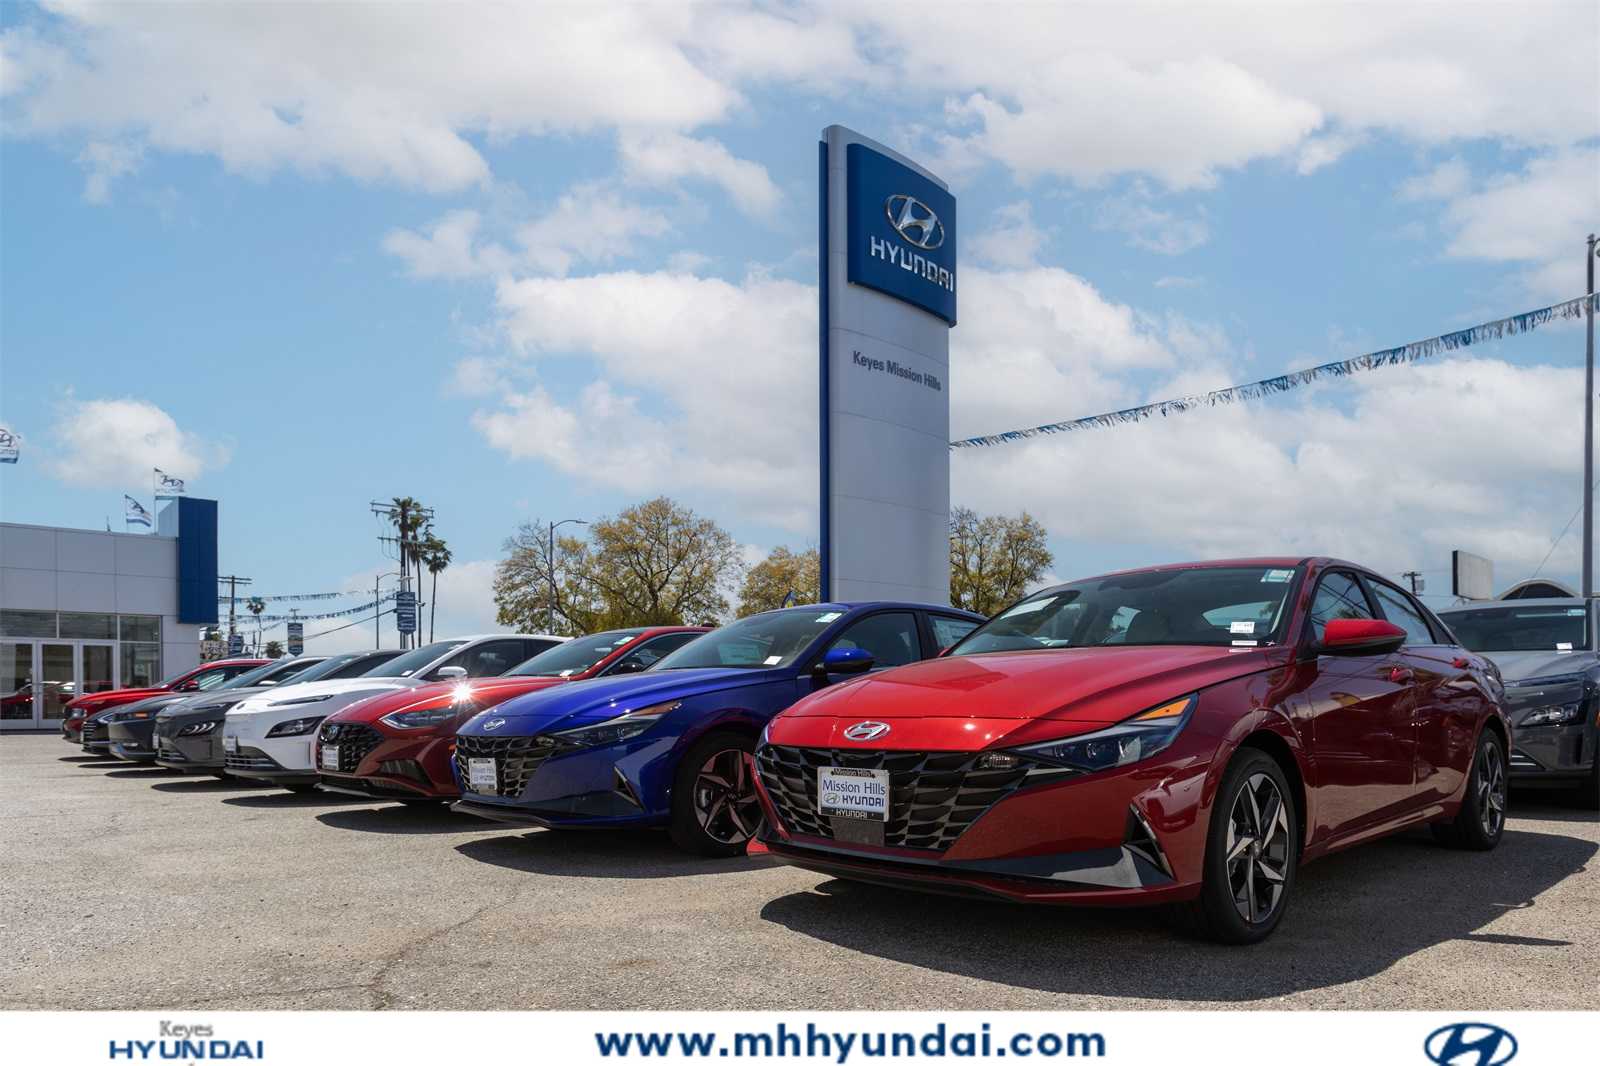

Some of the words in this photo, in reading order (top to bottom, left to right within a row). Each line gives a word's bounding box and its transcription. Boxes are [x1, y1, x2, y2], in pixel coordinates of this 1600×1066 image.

[871, 235, 953, 292] HYUNDAI
[853, 350, 885, 371] Keyes
[886, 360, 922, 384] Mission
[923, 373, 941, 391] Hills
[833, 768, 858, 777] Mission
[822, 780, 860, 793] Mission
[864, 782, 886, 795] Hills
[842, 795, 884, 807] HYUNDAI
[836, 808, 868, 819] HYUNDAI
